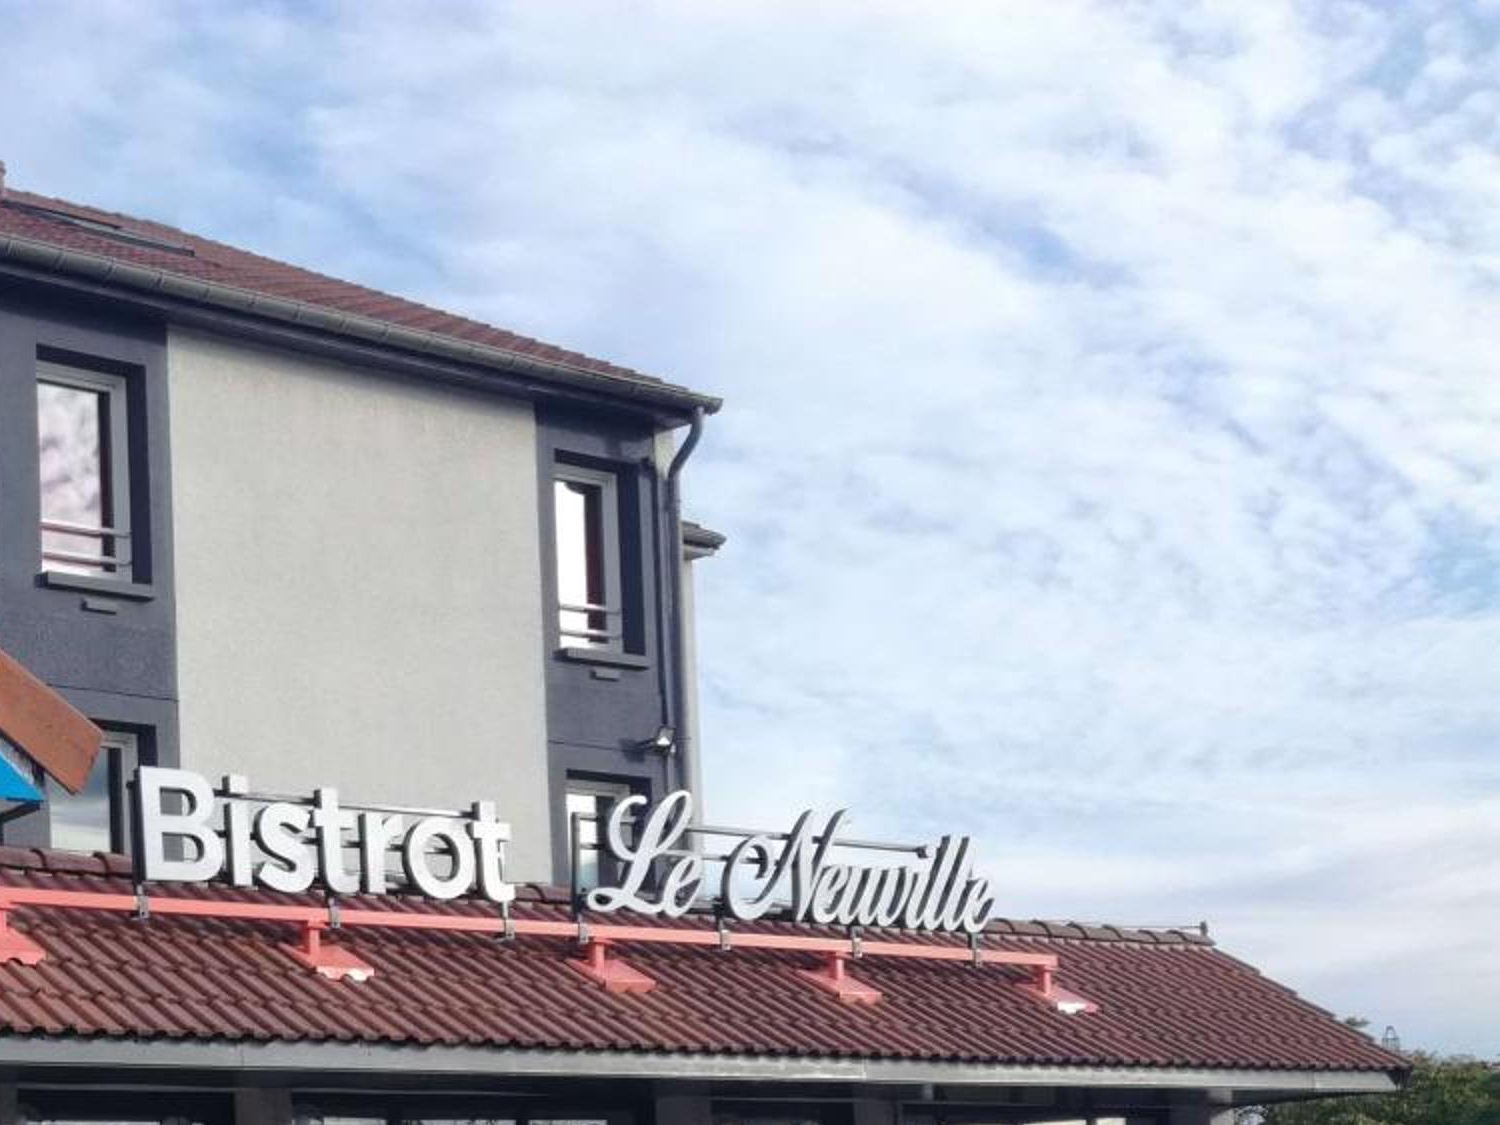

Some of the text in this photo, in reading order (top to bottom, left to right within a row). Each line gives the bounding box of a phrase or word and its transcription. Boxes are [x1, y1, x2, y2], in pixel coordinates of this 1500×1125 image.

[135, 766, 997, 933] Bistrot Le Neuville
